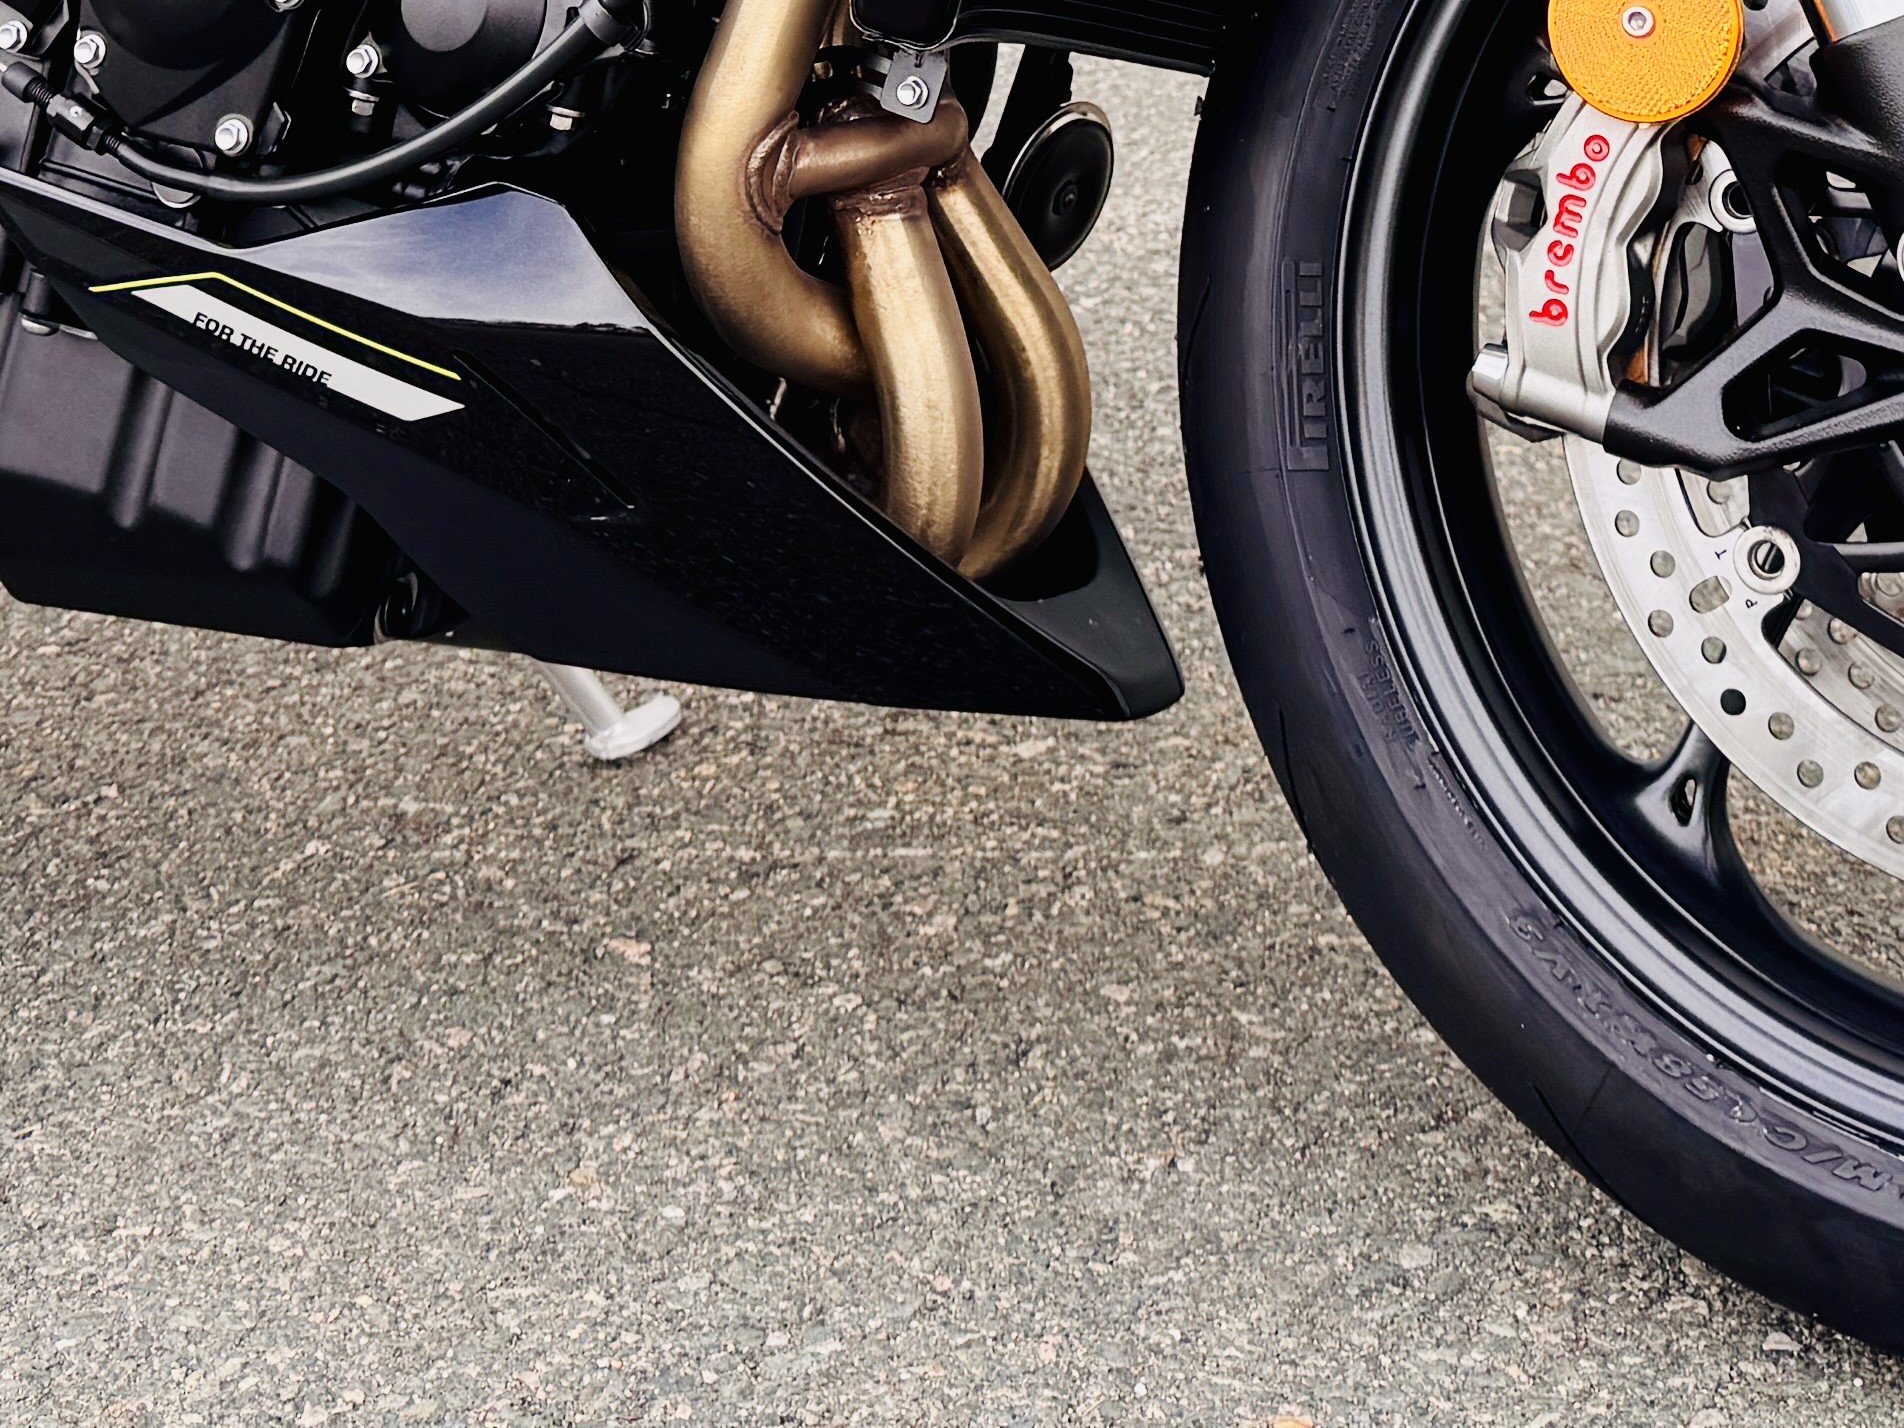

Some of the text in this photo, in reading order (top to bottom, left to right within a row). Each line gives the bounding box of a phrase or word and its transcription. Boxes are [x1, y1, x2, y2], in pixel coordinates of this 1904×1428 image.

[1528, 133, 1610, 328] brembo
[191, 311, 334, 388] FOR THE RIDE
[1282, 256, 1330, 472] PIRELLI
